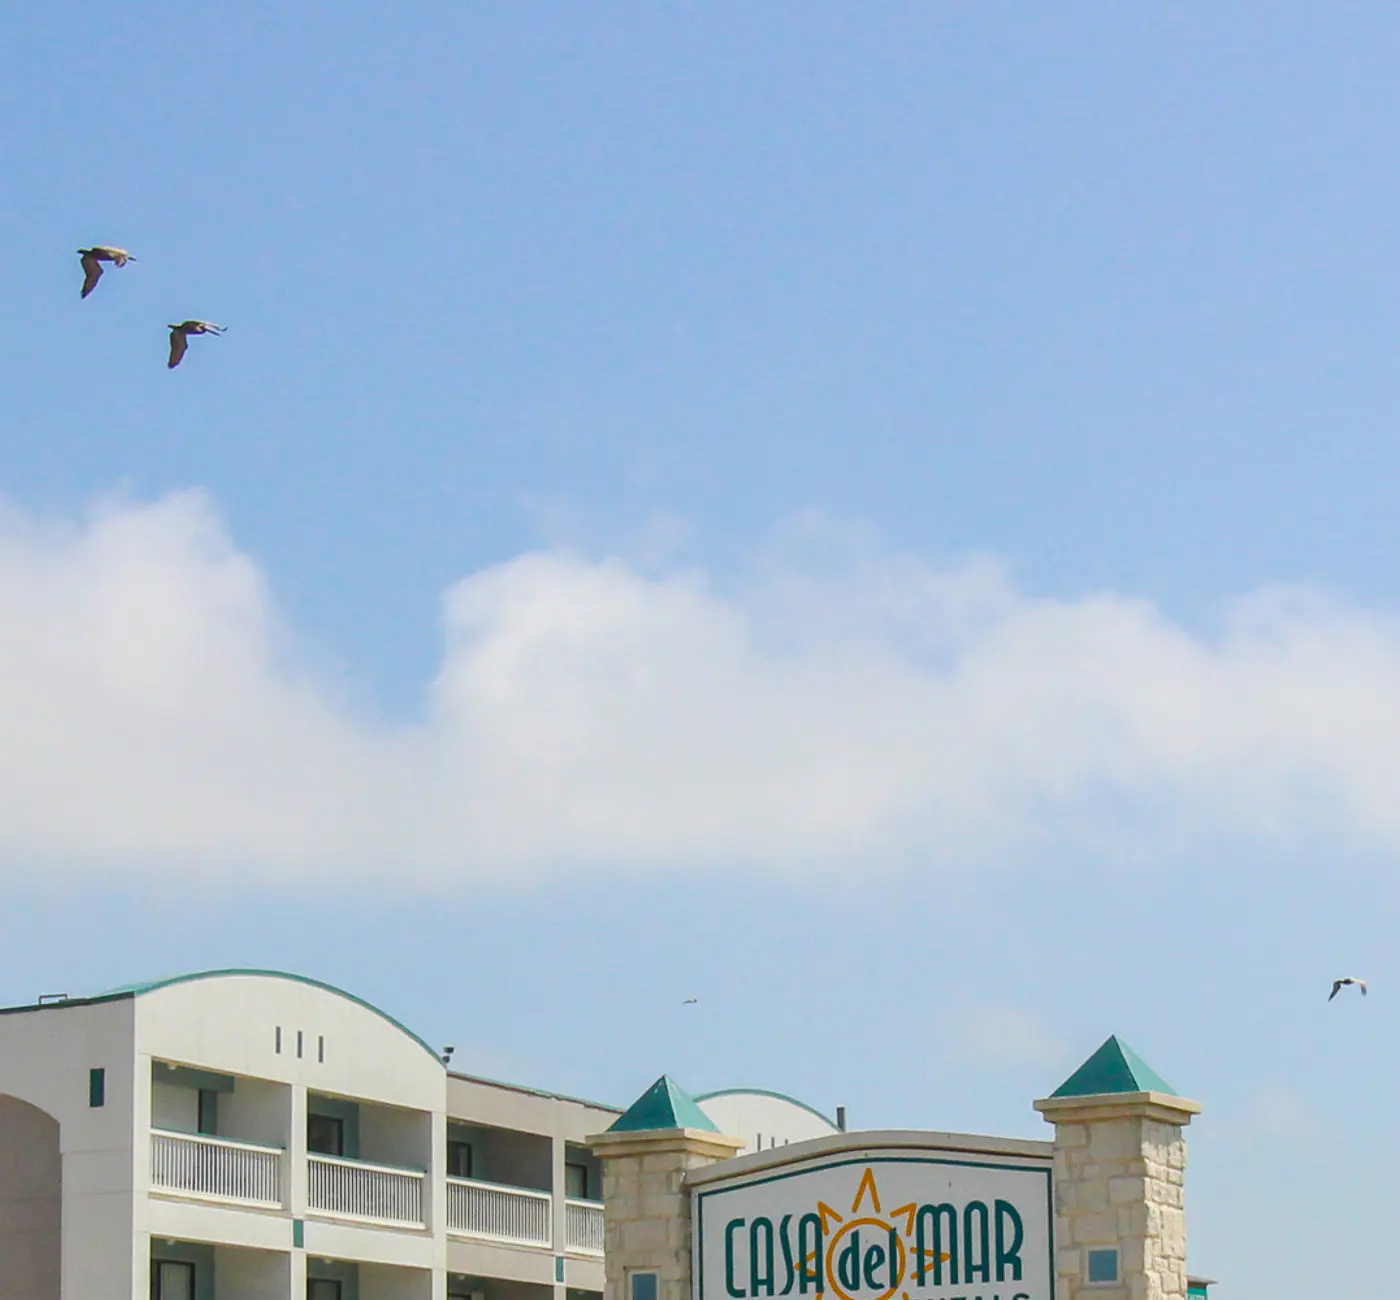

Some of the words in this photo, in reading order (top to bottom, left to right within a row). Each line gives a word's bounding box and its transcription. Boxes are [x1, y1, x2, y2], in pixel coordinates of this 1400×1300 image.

[725, 1213, 824, 1298] CASA
[838, 1226, 898, 1291] del
[916, 1199, 1023, 1287] MAR
